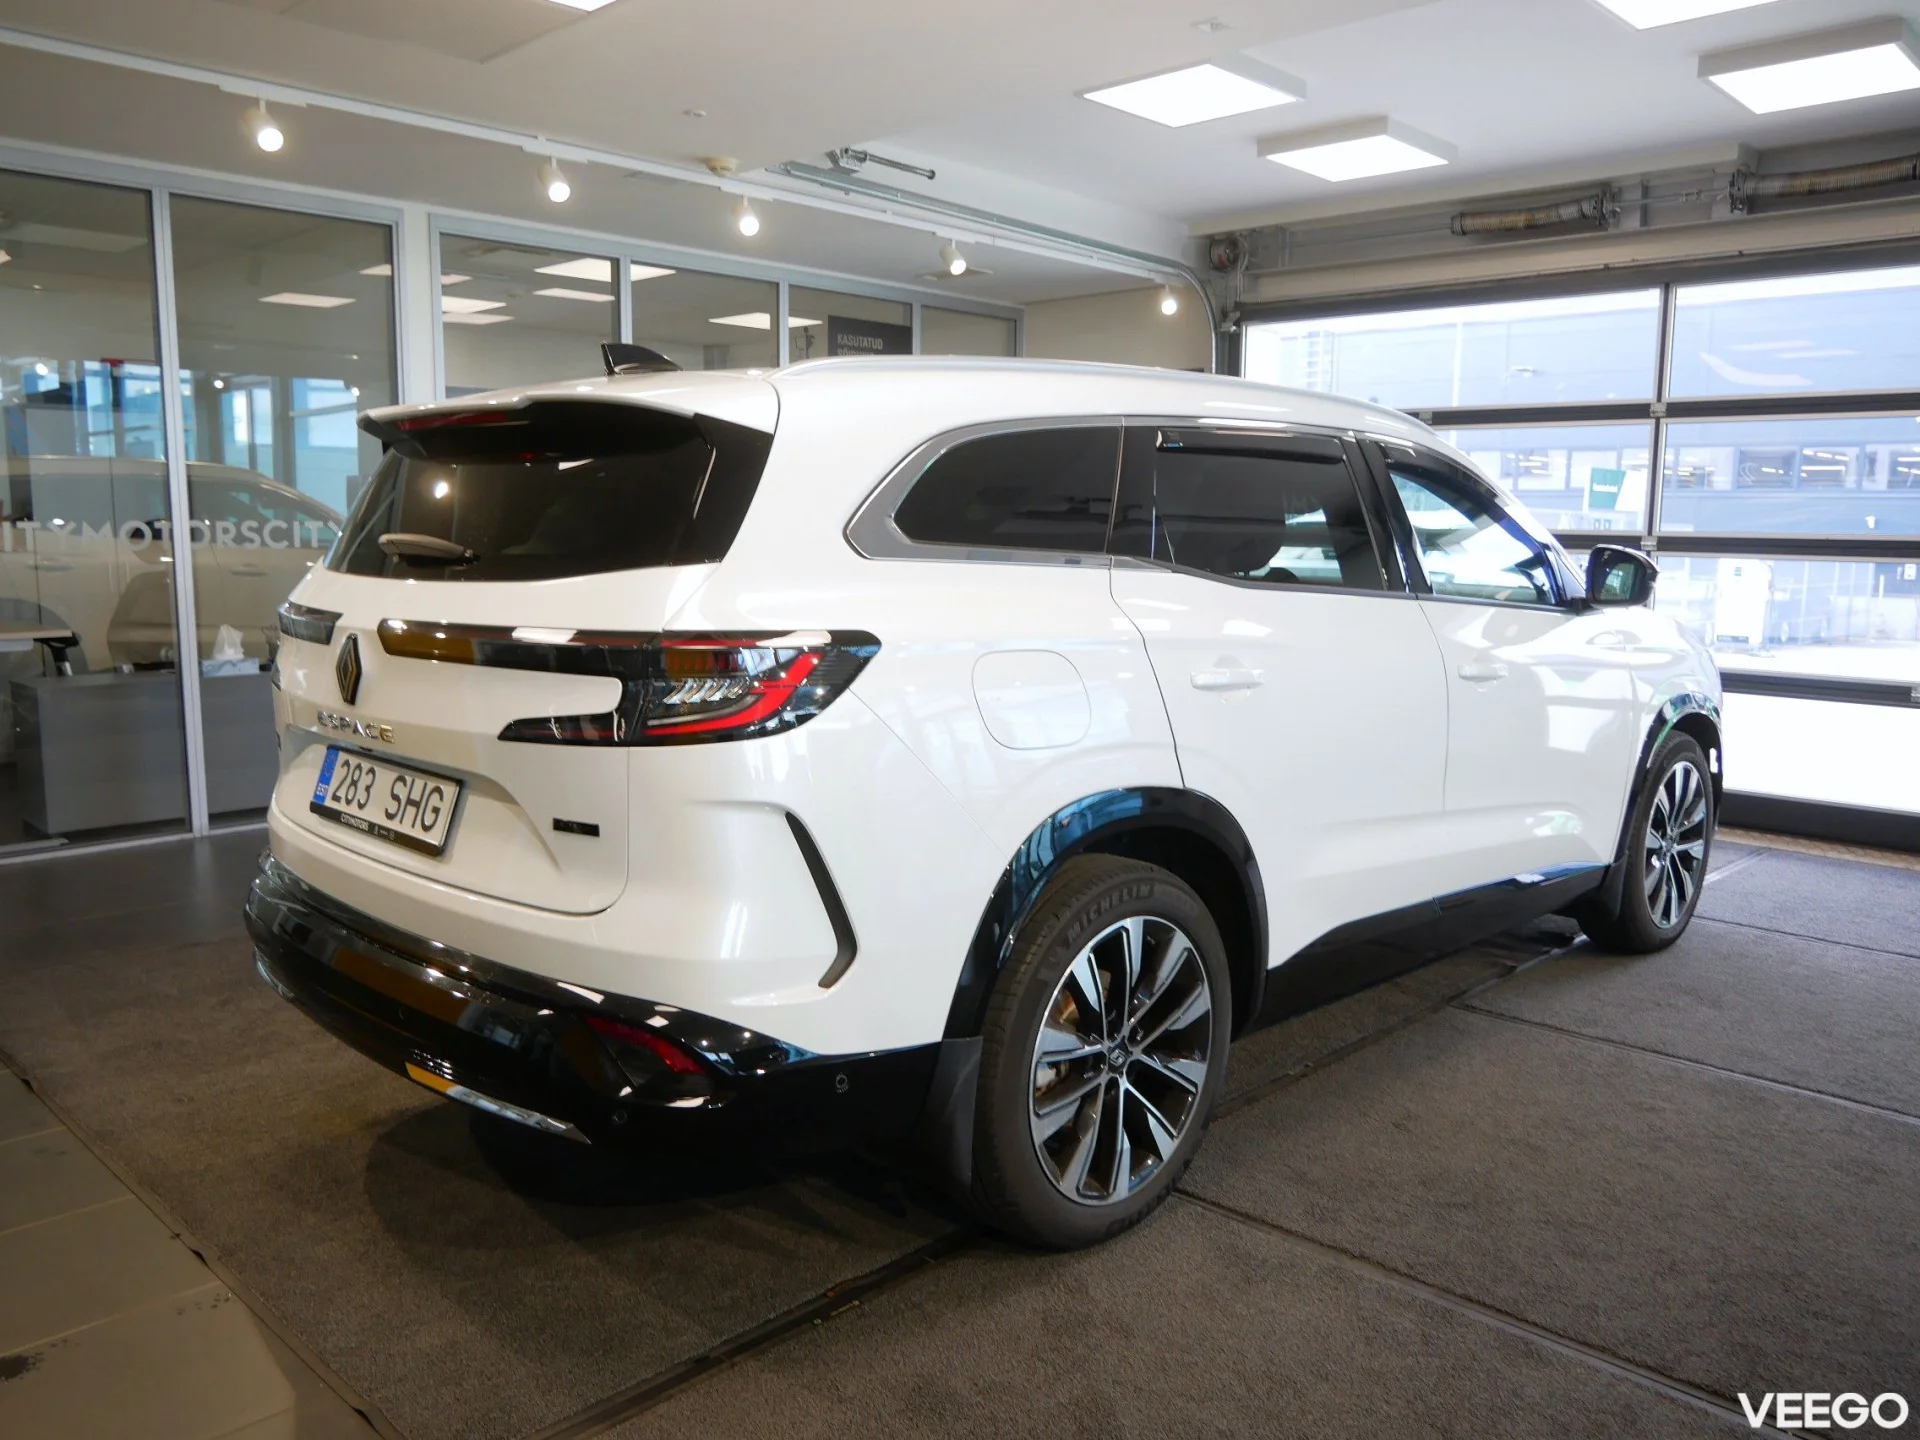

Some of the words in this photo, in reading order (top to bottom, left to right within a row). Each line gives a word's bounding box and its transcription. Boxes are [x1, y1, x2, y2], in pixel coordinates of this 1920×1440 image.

[837, 333, 883, 350] KASUTATUD
[317, 710, 396, 744] ESPACE
[331, 758, 377, 810] 283
[385, 774, 444, 833] SHG
[1066, 884, 1155, 944] MICHELIN
